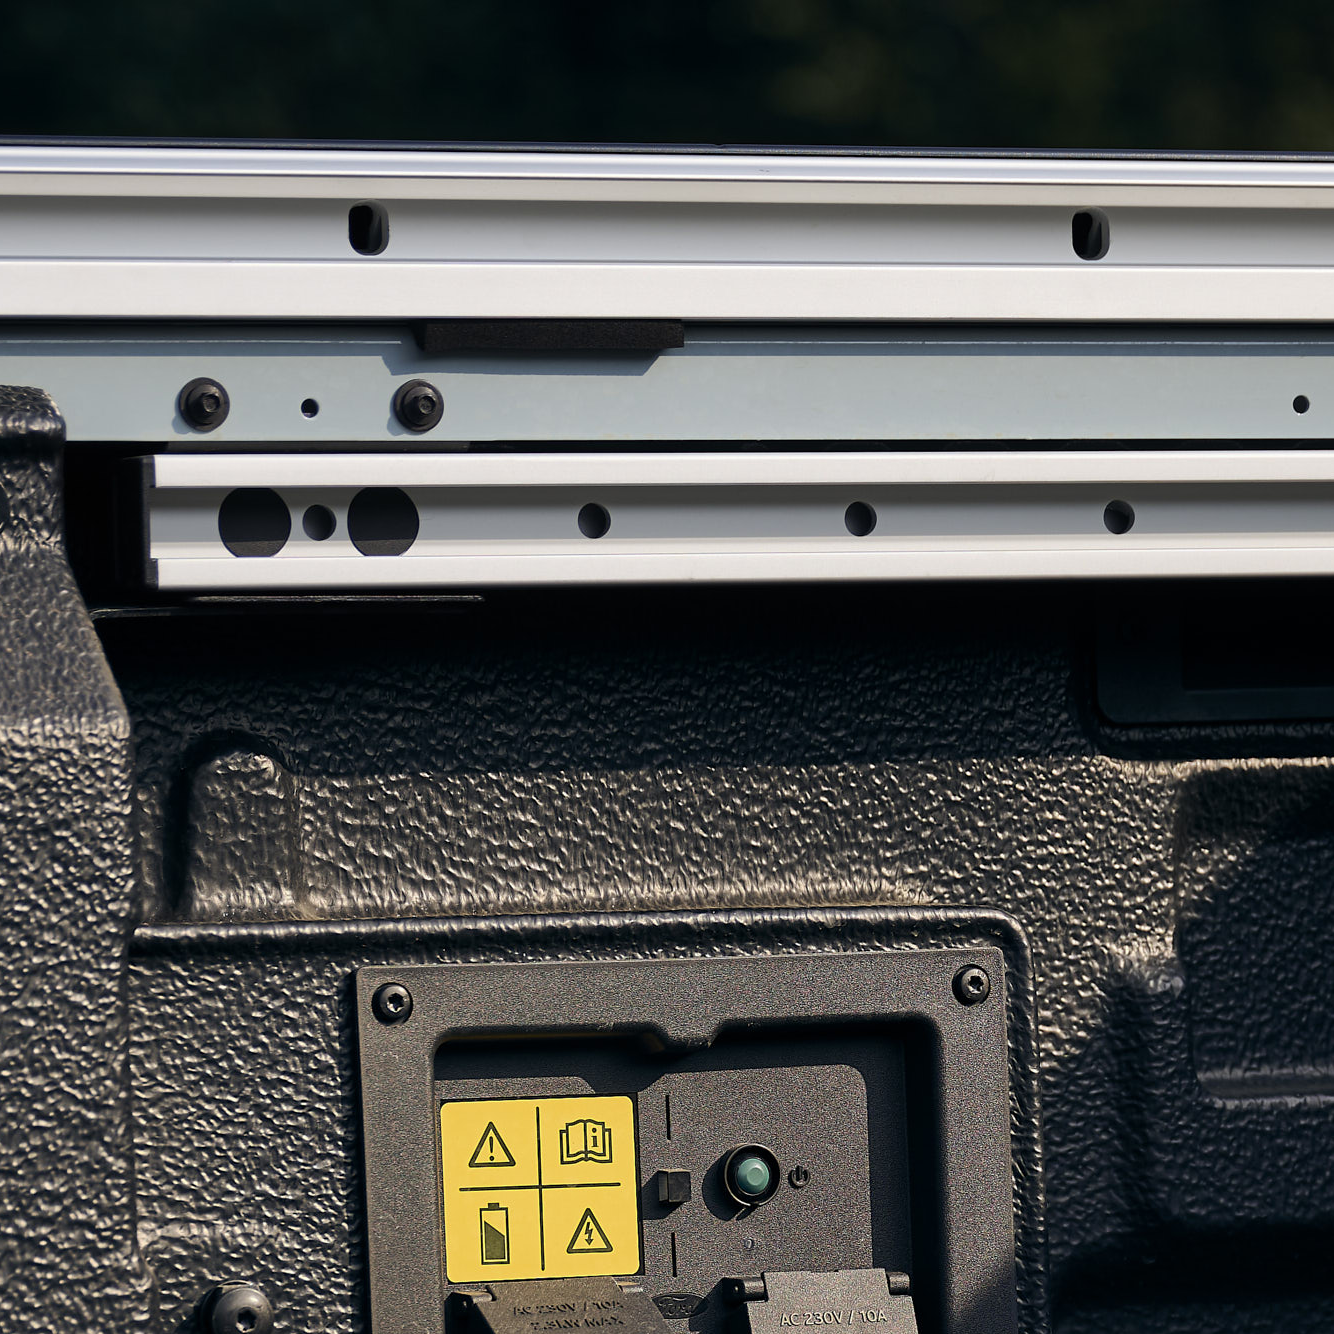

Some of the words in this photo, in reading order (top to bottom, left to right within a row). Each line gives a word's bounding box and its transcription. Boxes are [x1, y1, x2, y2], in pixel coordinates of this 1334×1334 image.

[780, 1312, 800, 1327] AC
[803, 1310, 843, 1326] 230V
[858, 1309, 887, 1323] 10A
